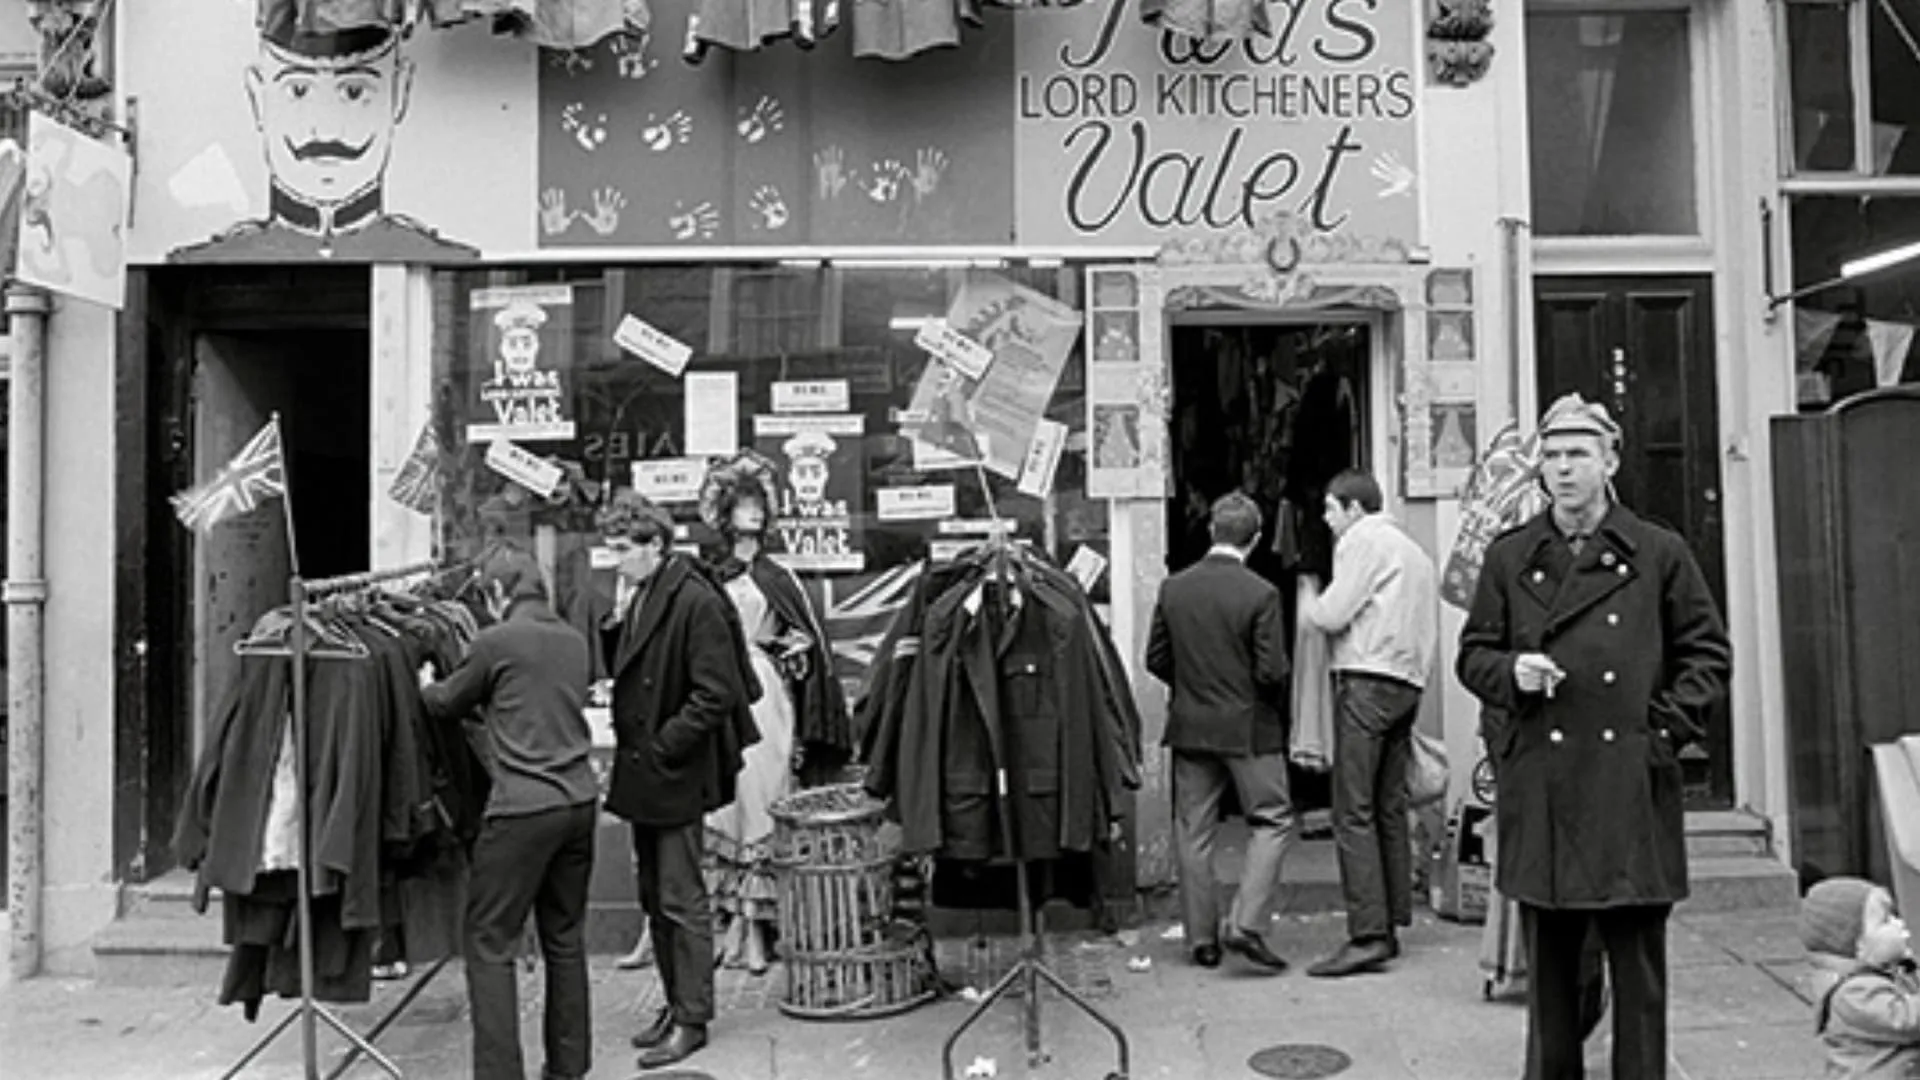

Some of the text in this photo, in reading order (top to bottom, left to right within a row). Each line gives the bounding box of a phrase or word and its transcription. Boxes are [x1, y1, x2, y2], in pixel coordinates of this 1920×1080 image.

[1020, 74, 1137, 118] LORD
[1063, 120, 1363, 232] Valet
[493, 396, 563, 424] Valet
[781, 527, 850, 554] Valet
